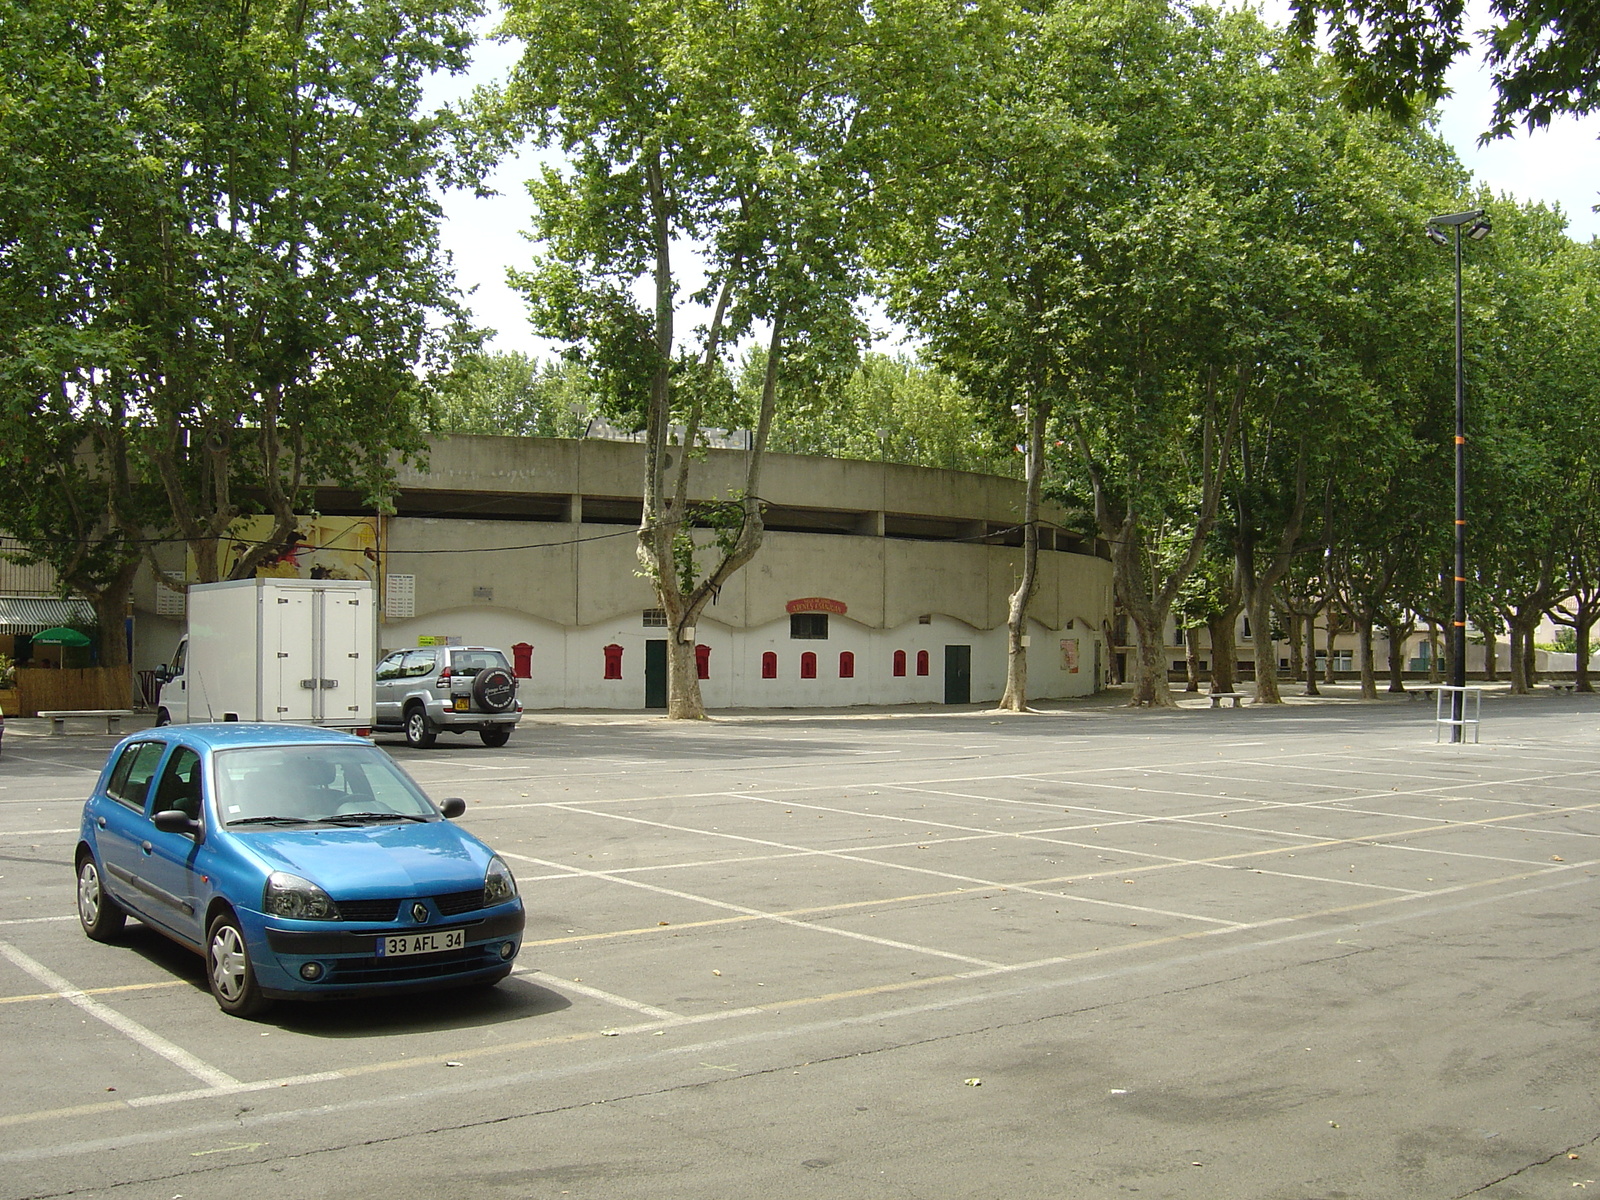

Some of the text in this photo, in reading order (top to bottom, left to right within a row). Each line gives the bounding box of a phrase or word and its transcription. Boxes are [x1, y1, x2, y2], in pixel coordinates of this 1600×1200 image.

[388, 932, 462, 954] 33 AFL 34
